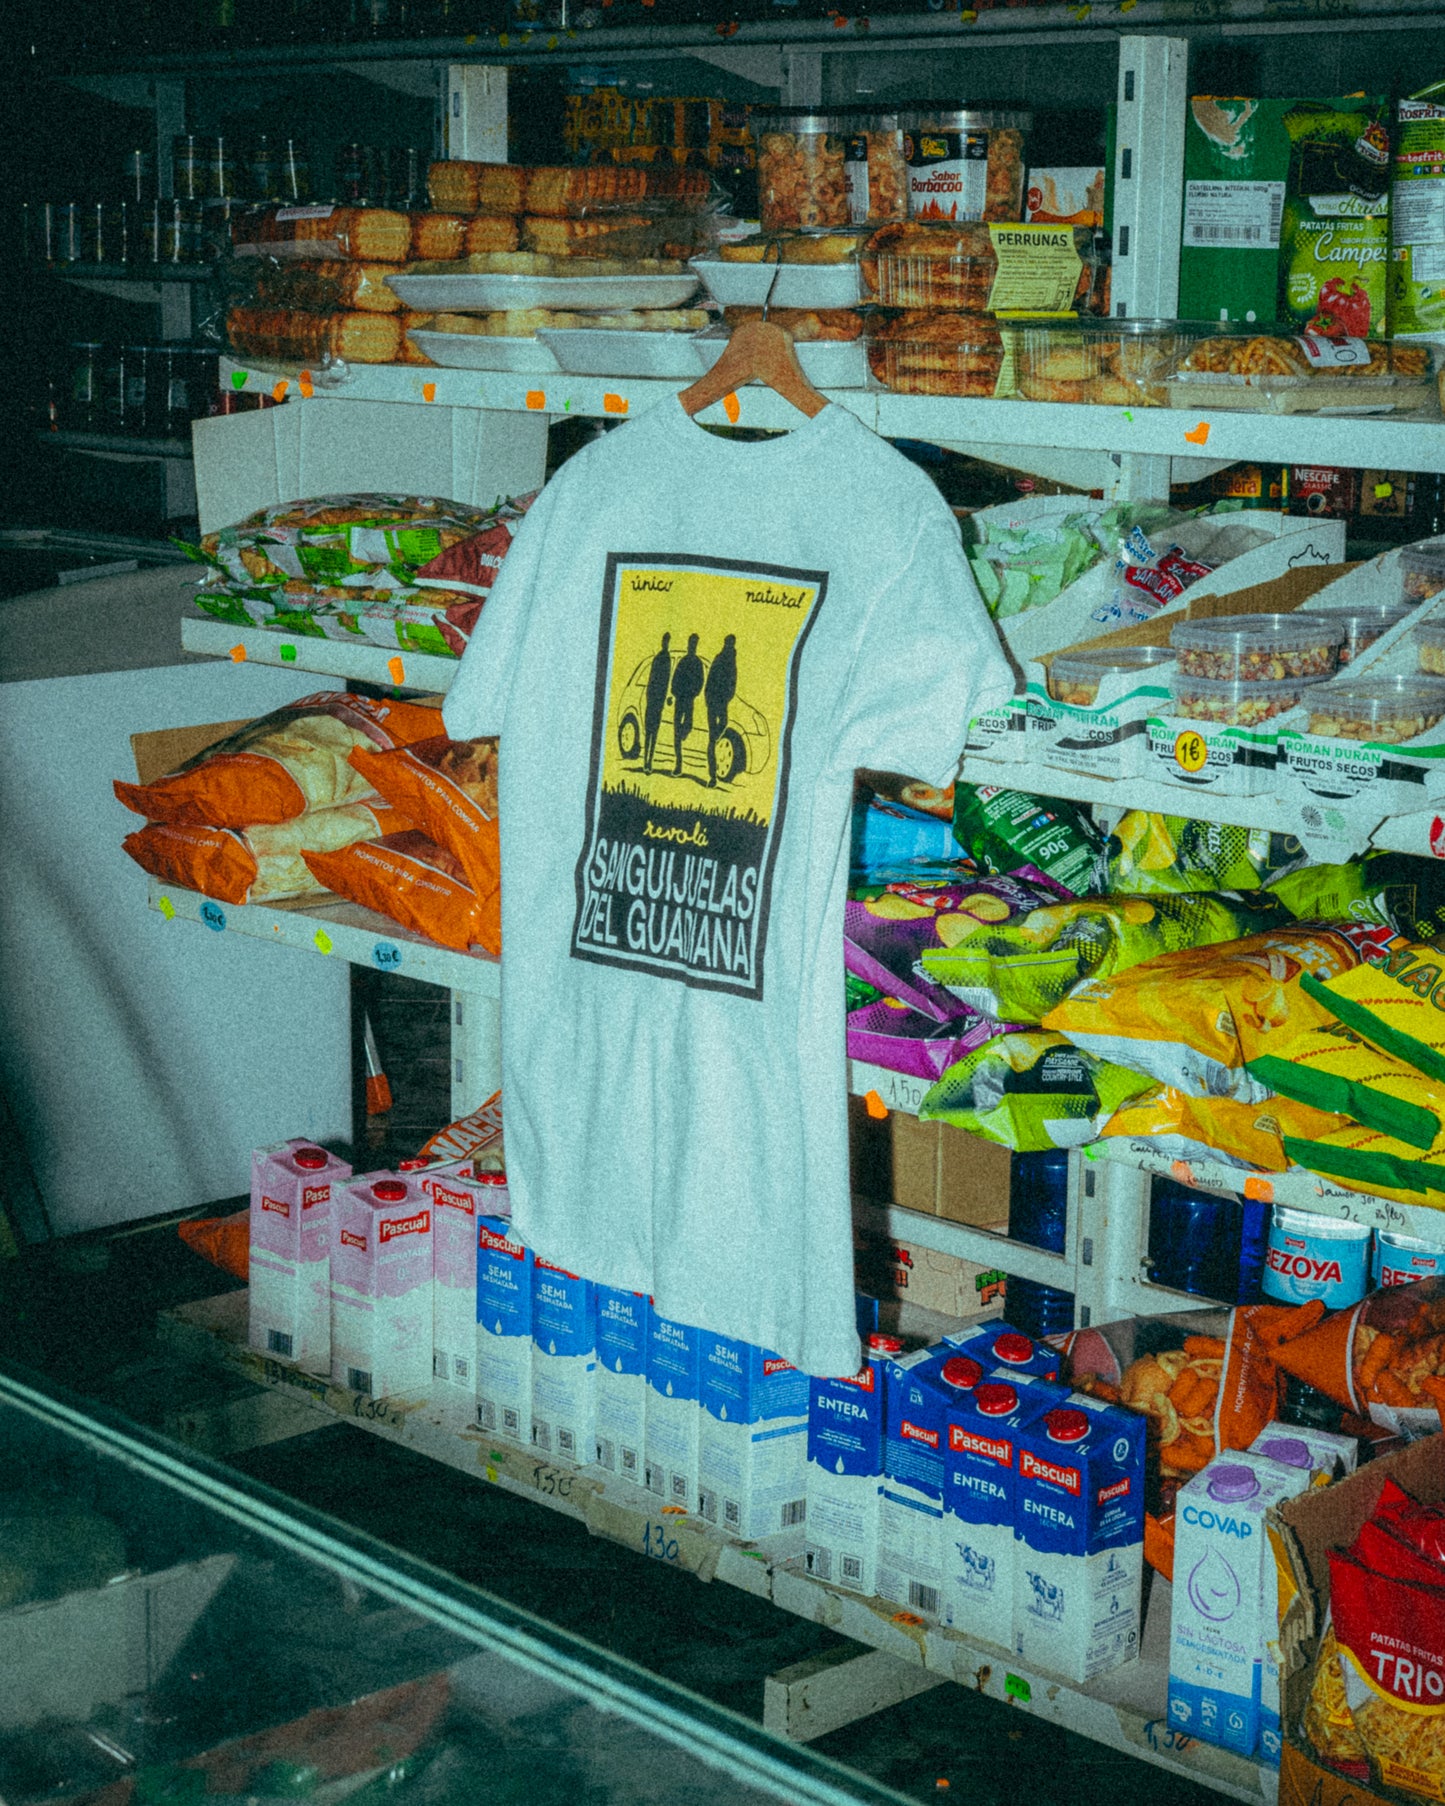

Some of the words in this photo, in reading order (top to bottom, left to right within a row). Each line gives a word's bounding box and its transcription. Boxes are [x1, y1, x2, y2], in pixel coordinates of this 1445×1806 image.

[911, 177, 963, 193] Barbacoa
[931, 170, 961, 181] Sabor
[1300, 221, 1335, 231] PATATAS
[1337, 222, 1364, 231] FRITAS
[998, 232, 1068, 247] PERRUNAS
[745, 586, 806, 609] natural
[1154, 742, 1175, 754] FRU
[1181, 737, 1200, 763] 1€
[1286, 740, 1330, 757] ROMAN
[1335, 747, 1380, 763] DURAN
[1289, 756, 1333, 771] FRUTOS
[1336, 762, 1374, 777] SECOS
[1038, 837, 1070, 861] 90g
[354, 849, 394, 874] MOMENTOS
[590, 837, 757, 920] SANGUIJUELAS
[580, 890, 618, 945] DEL
[627, 899, 749, 975] GUADIANA
[263, 1199, 289, 1215] Pascual
[436, 1186, 472, 1210] Pascual
[383, 1214, 427, 1236] Pascual
[343, 1232, 366, 1248] Pascual
[481, 1229, 522, 1255] Pascual
[482, 1273, 519, 1291] DESNATADA
[488, 1265, 512, 1280] SEMI
[536, 1293, 573, 1310] DESNATADA
[541, 1283, 566, 1299] SEMI
[601, 1309, 638, 1328] DESNATADA
[608, 1300, 633, 1317] SEMI
[653, 1331, 690, 1352] DESNATADA
[660, 1322, 684, 1340] SEMI
[715, 1344, 739, 1362] SEMI
[708, 1354, 743, 1374] DESNATADA
[1234, 1368, 1250, 1413] MOMENTOS
[818, 1396, 869, 1421] ENTERA
[1006, 1416, 1021, 1428] 1L
[903, 1423, 938, 1445] Pascual
[953, 1429, 1009, 1461] Pascual
[1075, 1444, 1091, 1456] 1L
[1022, 1455, 1077, 1489] Pascual
[953, 1472, 1007, 1501] ENTERA
[1098, 1482, 1128, 1502] Pascual
[1023, 1499, 1075, 1529] ENTERA
[1181, 1504, 1253, 1540] COVAP
[1176, 1623, 1194, 1638] SIN
[1198, 1632, 1247, 1655] LACTOSA
[1370, 1632, 1411, 1654] PATATAS
[1412, 1645, 1444, 1666] FRITAS
[1370, 1649, 1445, 1698] TRIO
